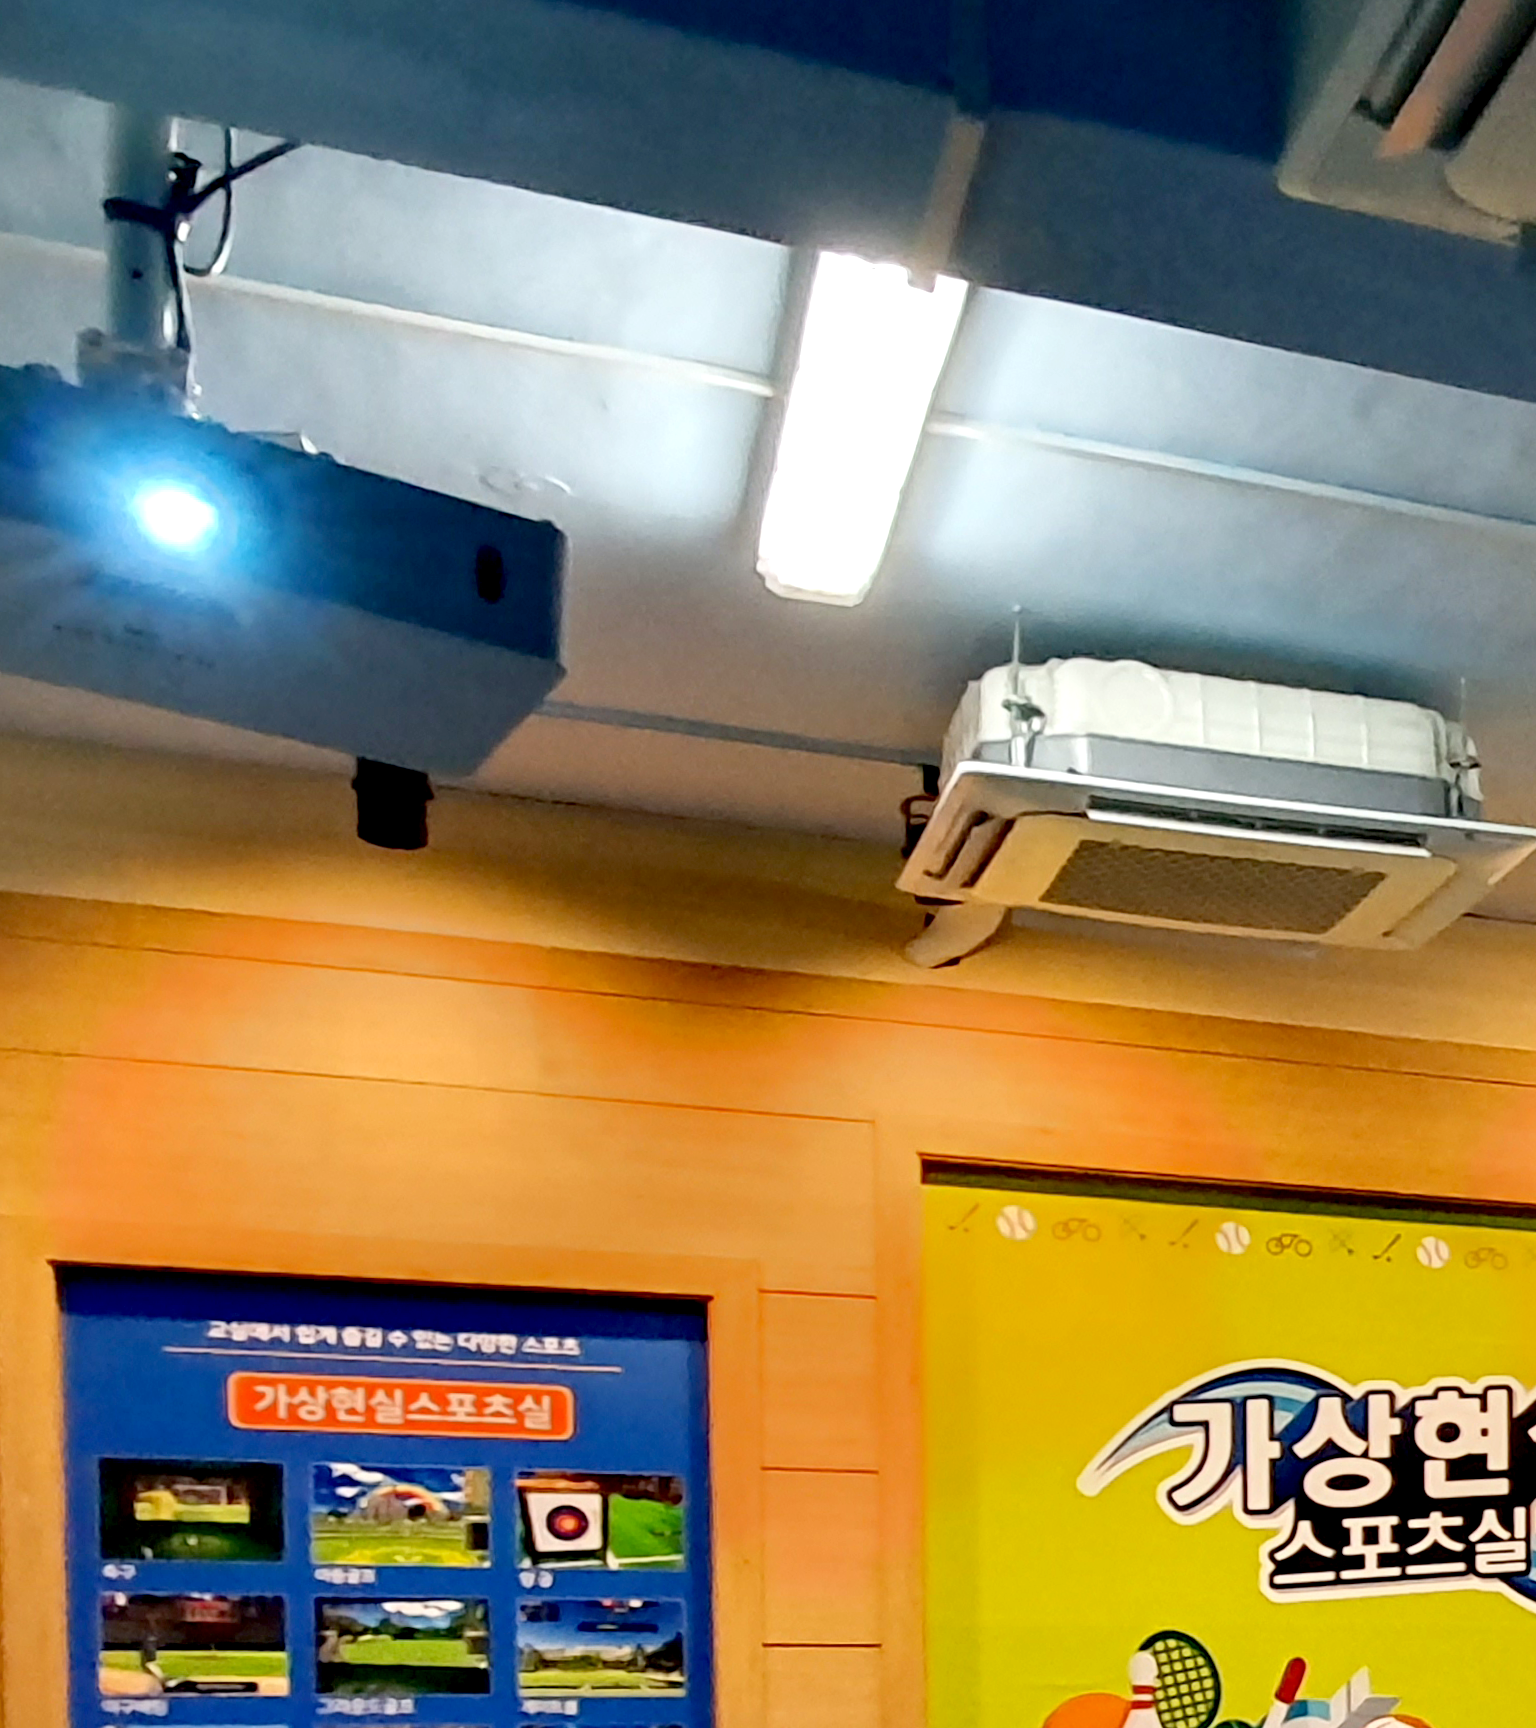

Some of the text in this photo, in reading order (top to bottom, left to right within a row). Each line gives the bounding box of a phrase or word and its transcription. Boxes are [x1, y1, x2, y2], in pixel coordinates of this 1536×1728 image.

[387, 1330, 409, 1348] 수
[411, 1329, 454, 1351] 있는
[521, 1336, 582, 1356] 스포츠
[252, 1384, 553, 1431] 가상현실스포츠실
[1272, 1505, 1528, 1585] 스포츠실
